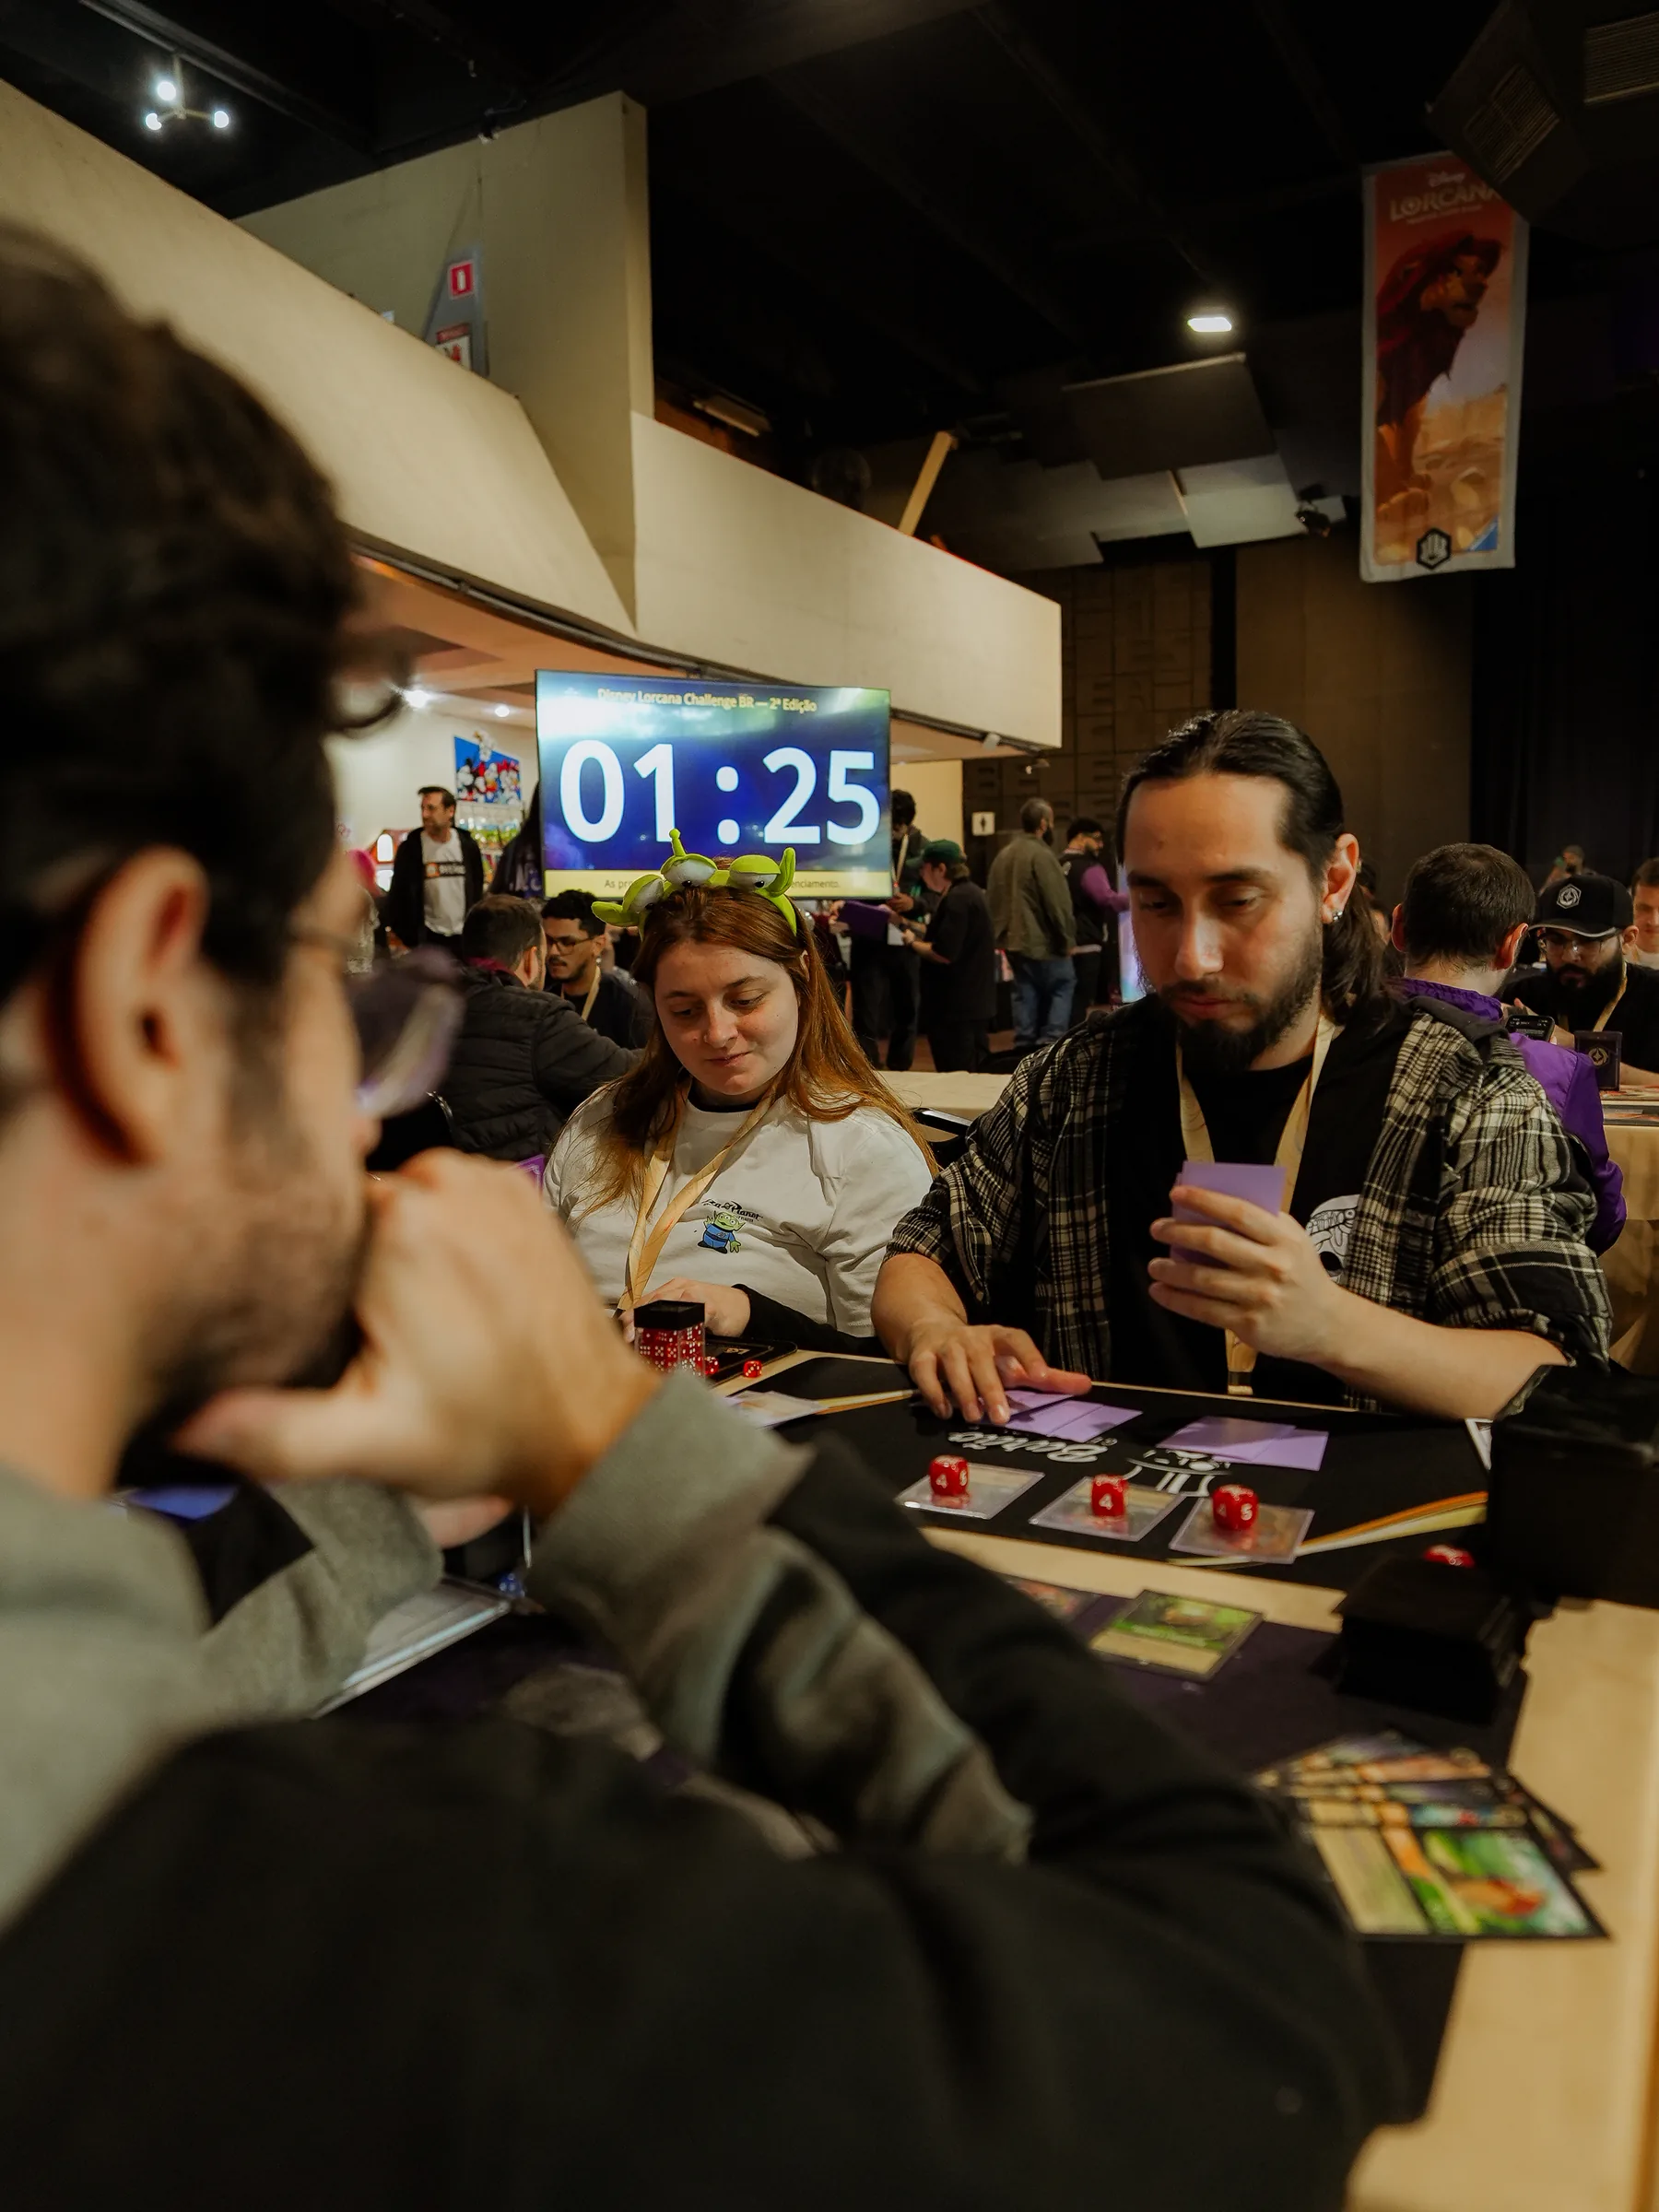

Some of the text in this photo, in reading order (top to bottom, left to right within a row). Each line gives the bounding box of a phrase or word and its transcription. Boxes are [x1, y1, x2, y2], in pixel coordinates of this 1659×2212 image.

[598, 688, 636, 703] Disney
[638, 690, 682, 705] Lorcana
[683, 692, 736, 710] Challenge
[738, 696, 755, 708] BR
[782, 698, 818, 713] Edição
[605, 879, 615, 888] As
